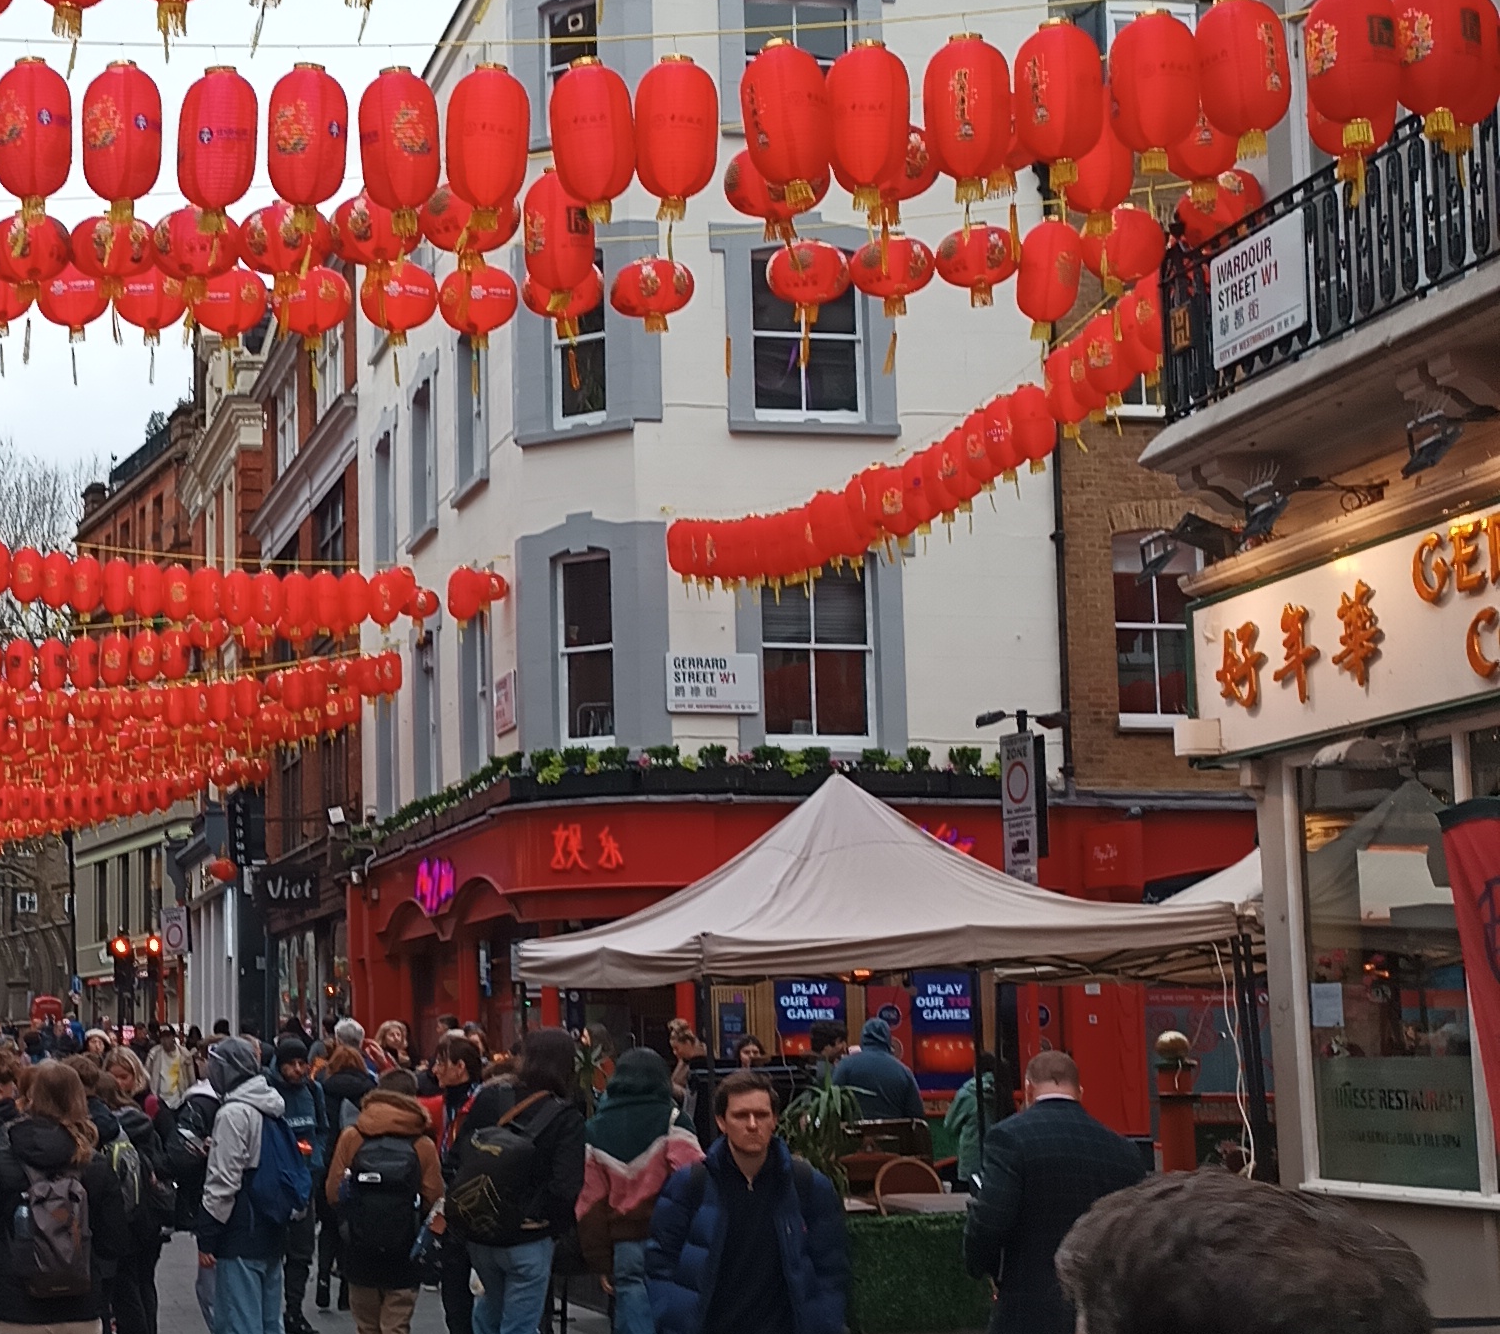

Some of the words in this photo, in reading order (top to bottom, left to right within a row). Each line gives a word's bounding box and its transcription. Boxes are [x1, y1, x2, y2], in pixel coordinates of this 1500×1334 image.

[1217, 236, 1272, 286] WARDOUR
[1218, 271, 1259, 312] STREET
[1261, 260, 1278, 288] W1
[1216, 579, 1385, 709] 好年華
[1466, 607, 1500, 679] C
[673, 656, 727, 670] GERRARD
[674, 671, 715, 684] STREET
[719, 671, 736, 684] W1
[1006, 745, 1028, 761] ZONE
[791, 983, 828, 995] PLAY
[927, 983, 964, 995] PLAY
[780, 995, 809, 1008] OUR
[812, 996, 841, 1007] TOP
[916, 996, 944, 1008] OUR
[786, 1008, 835, 1020] GAMES
[922, 1008, 970, 1020] GAMES
[1329, 1087, 1376, 1111] HINESE
